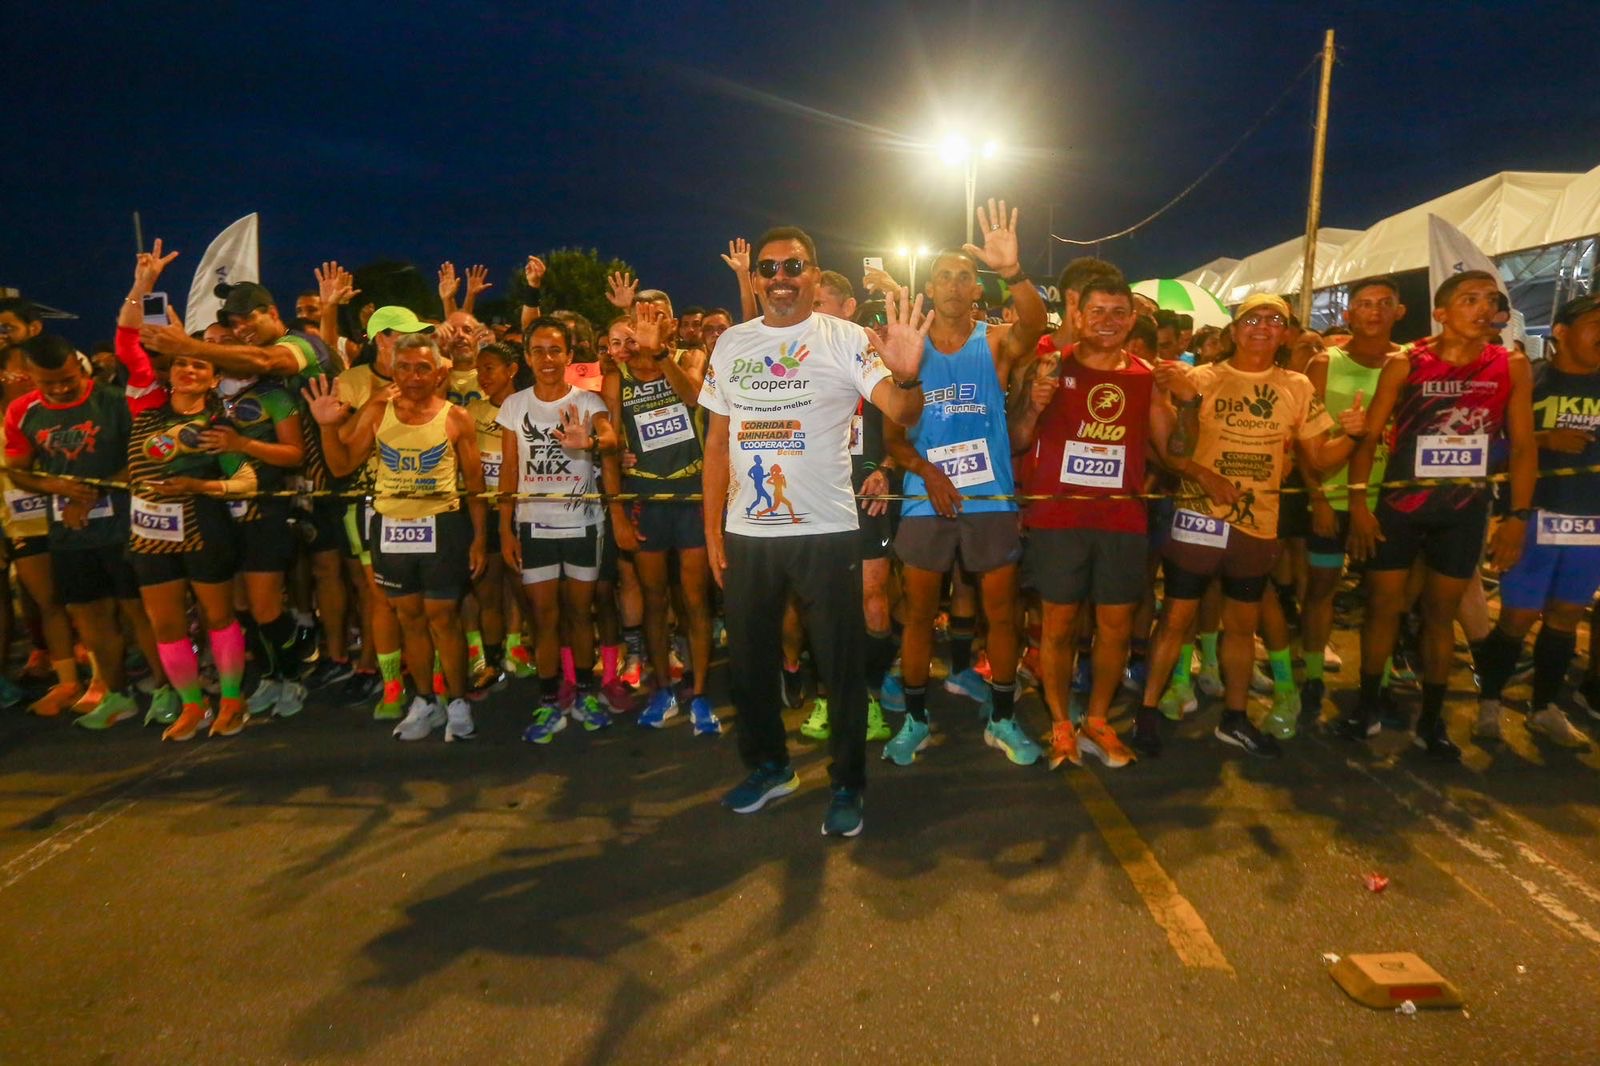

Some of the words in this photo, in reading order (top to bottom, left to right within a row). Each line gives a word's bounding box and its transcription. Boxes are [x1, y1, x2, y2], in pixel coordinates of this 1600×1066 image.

[731, 358, 764, 374] Dia
[729, 374, 740, 383] de
[740, 375, 810, 392] Cooperar
[783, 399, 812, 410] melhor
[944, 403, 987, 415] runners
[1215, 398, 1244, 413] Dia
[646, 418, 682, 438] 0545
[744, 421, 784, 430] CORRIDA
[786, 421, 793, 429] E
[1225, 413, 1280, 430] Cooperar
[1430, 450, 1472, 465] 1718
[525, 460, 573, 475] NIX
[941, 456, 978, 476] 1763
[1072, 458, 1115, 476] 0220
[135, 512, 170, 530] 1675
[1180, 514, 1216, 533] 1798
[1550, 519, 1595, 533] 1054
[389, 527, 426, 541] 1303
